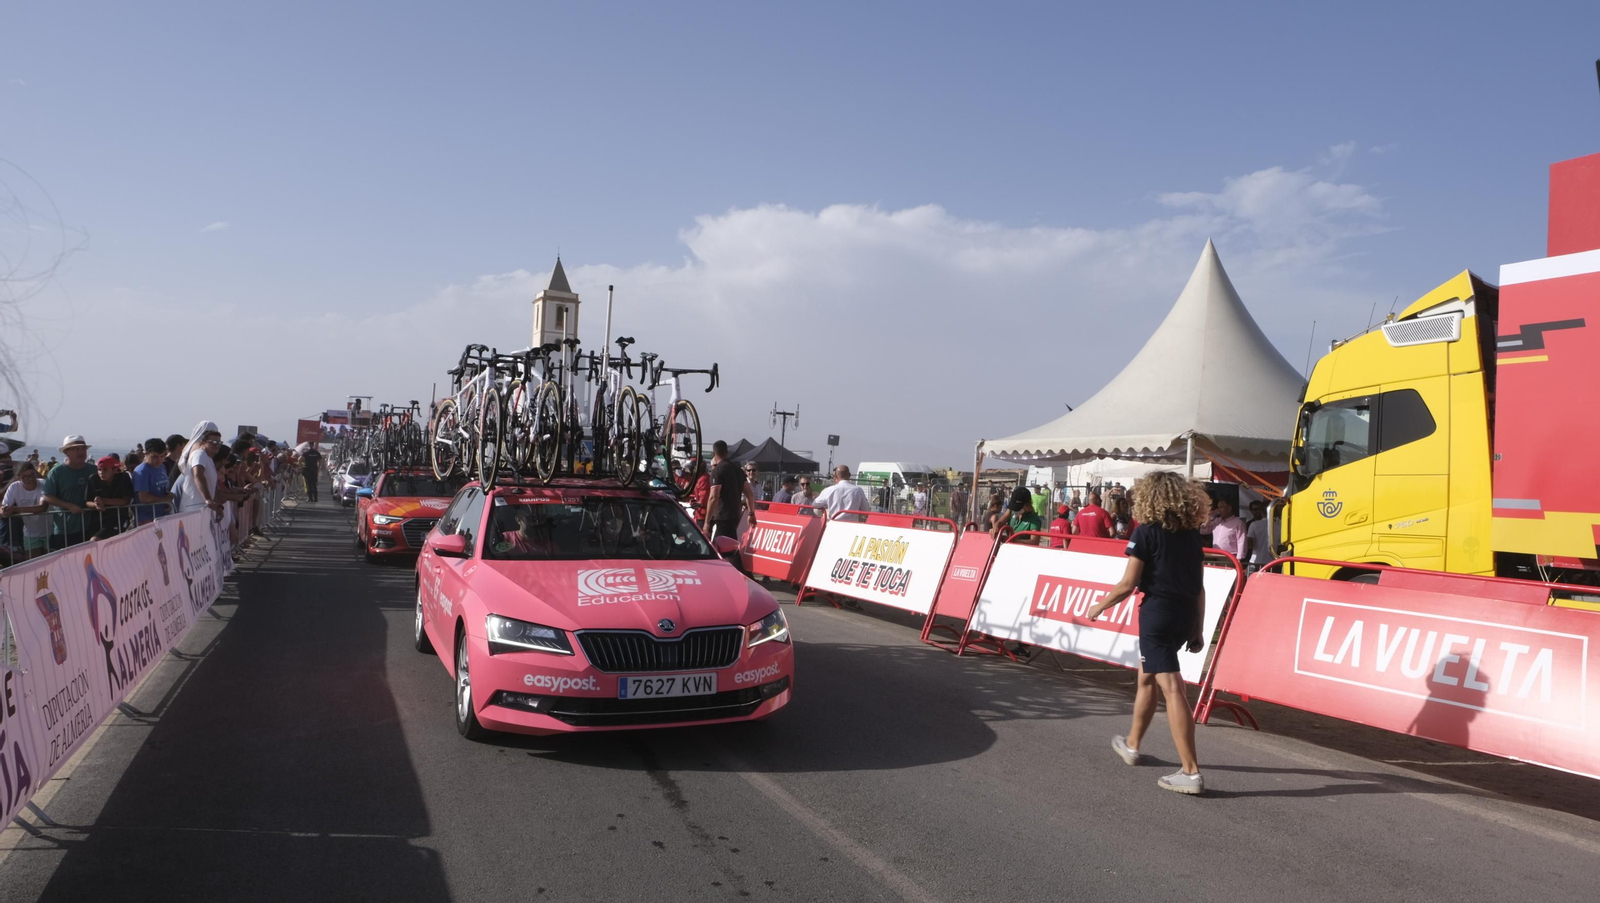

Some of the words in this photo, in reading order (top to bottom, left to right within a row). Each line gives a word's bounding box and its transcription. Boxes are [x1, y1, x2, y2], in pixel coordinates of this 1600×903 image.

[750, 527, 764, 549] LA
[761, 528, 796, 555] VUELTA
[848, 535, 866, 558] LA
[863, 536, 909, 565] PASIÓN
[831, 558, 859, 583] QUE
[857, 562, 876, 587] TE
[874, 565, 912, 595] TOCA
[953, 568, 961, 577] LA
[960, 568, 976, 579] VUELTA
[120, 586, 143, 626] COSTA
[141, 580, 154, 609] DE
[578, 592, 680, 606] Education
[1037, 582, 1062, 612] LA
[117, 609, 161, 690] ALMERÍA
[1314, 616, 1364, 667] LA
[1376, 623, 1553, 703] VUELTA
[524, 673, 601, 692] easypost.
[632, 678, 676, 697] 7627
[682, 675, 713, 694] KVN
[735, 660, 781, 684] easypost.
[42, 668, 90, 731] DIPUTACIÓN
[49, 739, 61, 768] DE
[61, 699, 94, 756] ALMERÍA
